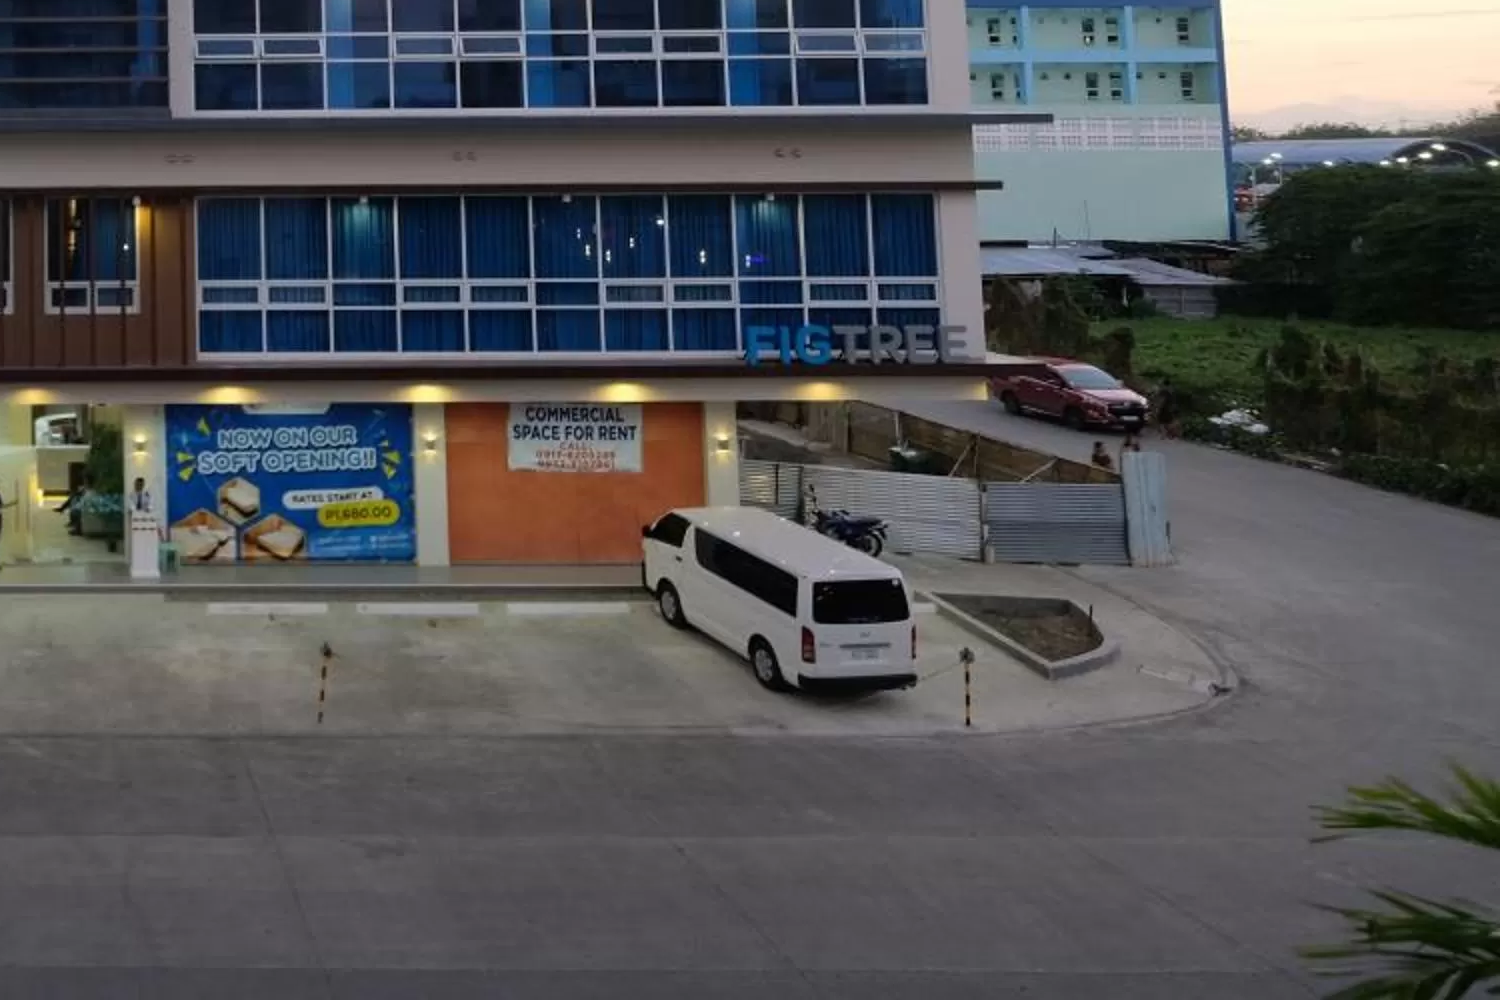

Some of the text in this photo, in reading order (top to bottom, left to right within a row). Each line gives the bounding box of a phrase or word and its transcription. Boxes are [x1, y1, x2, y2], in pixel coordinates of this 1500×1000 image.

[744, 323, 973, 366] FIGTREE
[525, 407, 625, 422] COMMERCIAL
[218, 425, 357, 449] NOW ON OUR
[513, 424, 637, 440] SPACE FOR RENT
[198, 448, 377, 475] SOFT OPENING!!
